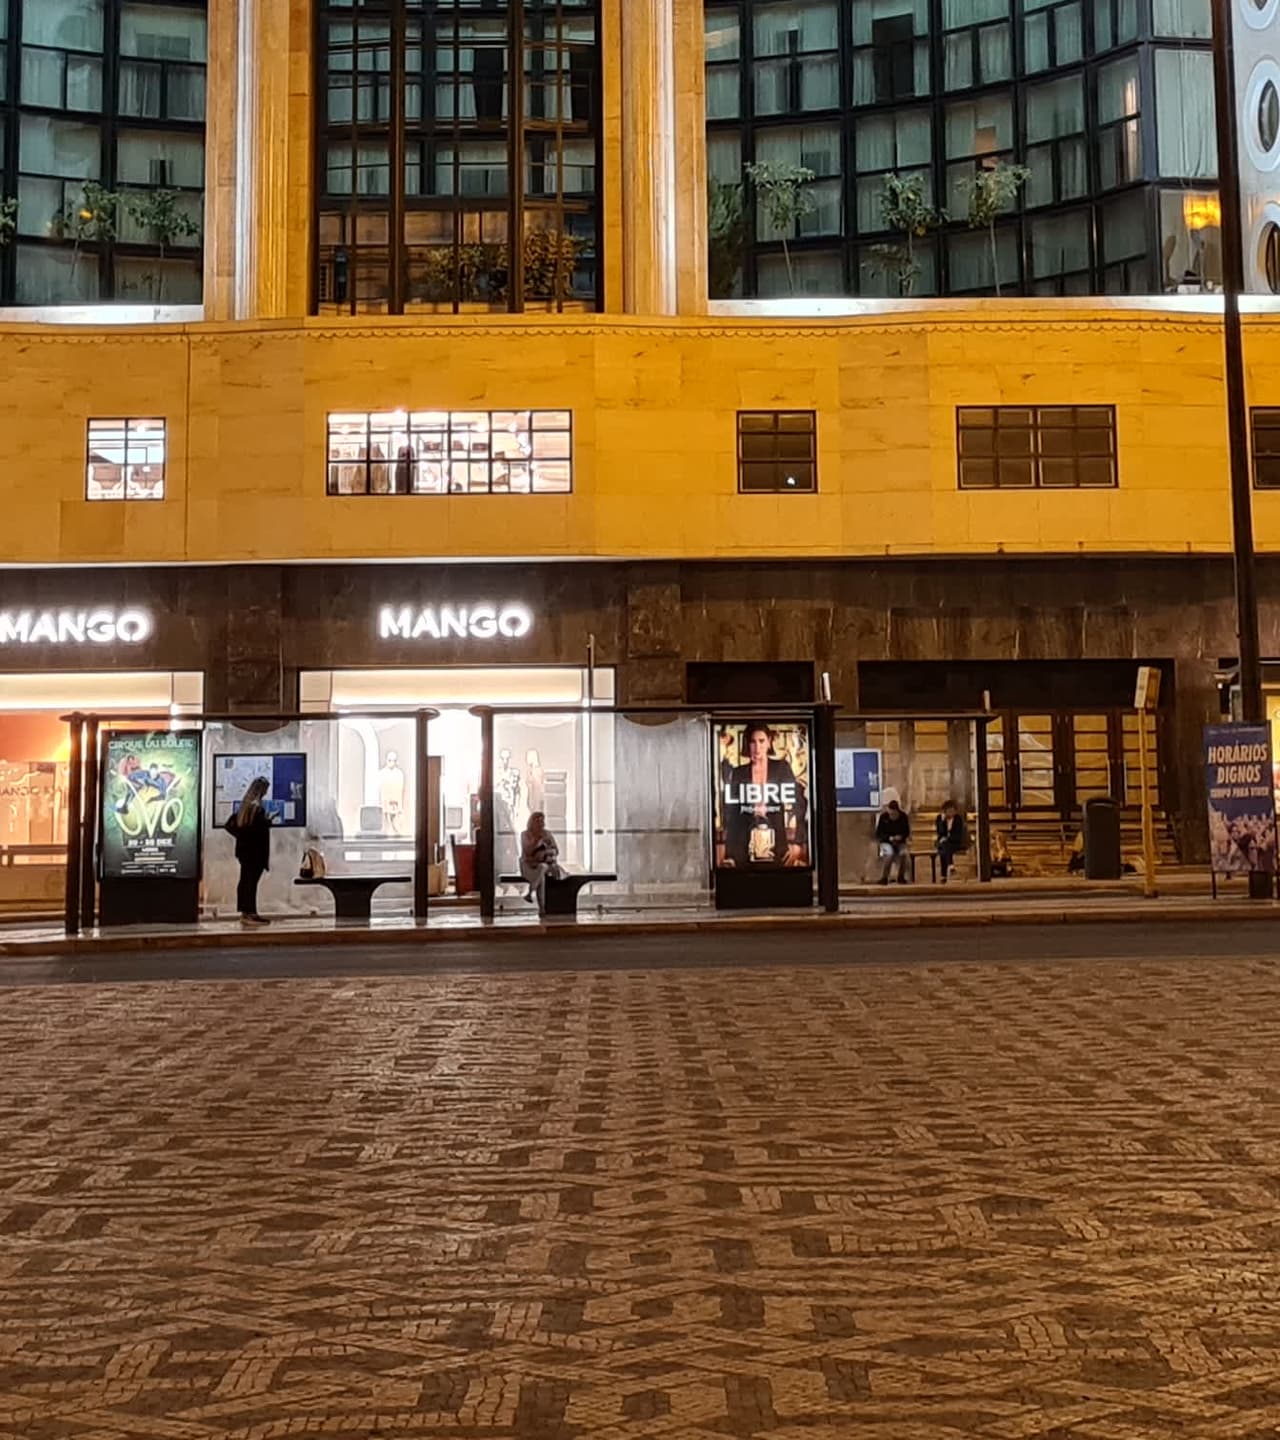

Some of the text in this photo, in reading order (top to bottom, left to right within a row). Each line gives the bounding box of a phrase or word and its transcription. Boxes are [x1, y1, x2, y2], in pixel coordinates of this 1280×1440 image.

[379, 605, 531, 639] MANGO
[1207, 740, 1269, 764] HORÁRIOS
[1216, 765, 1262, 784] DIGNOS
[724, 782, 797, 804] LIBRE
